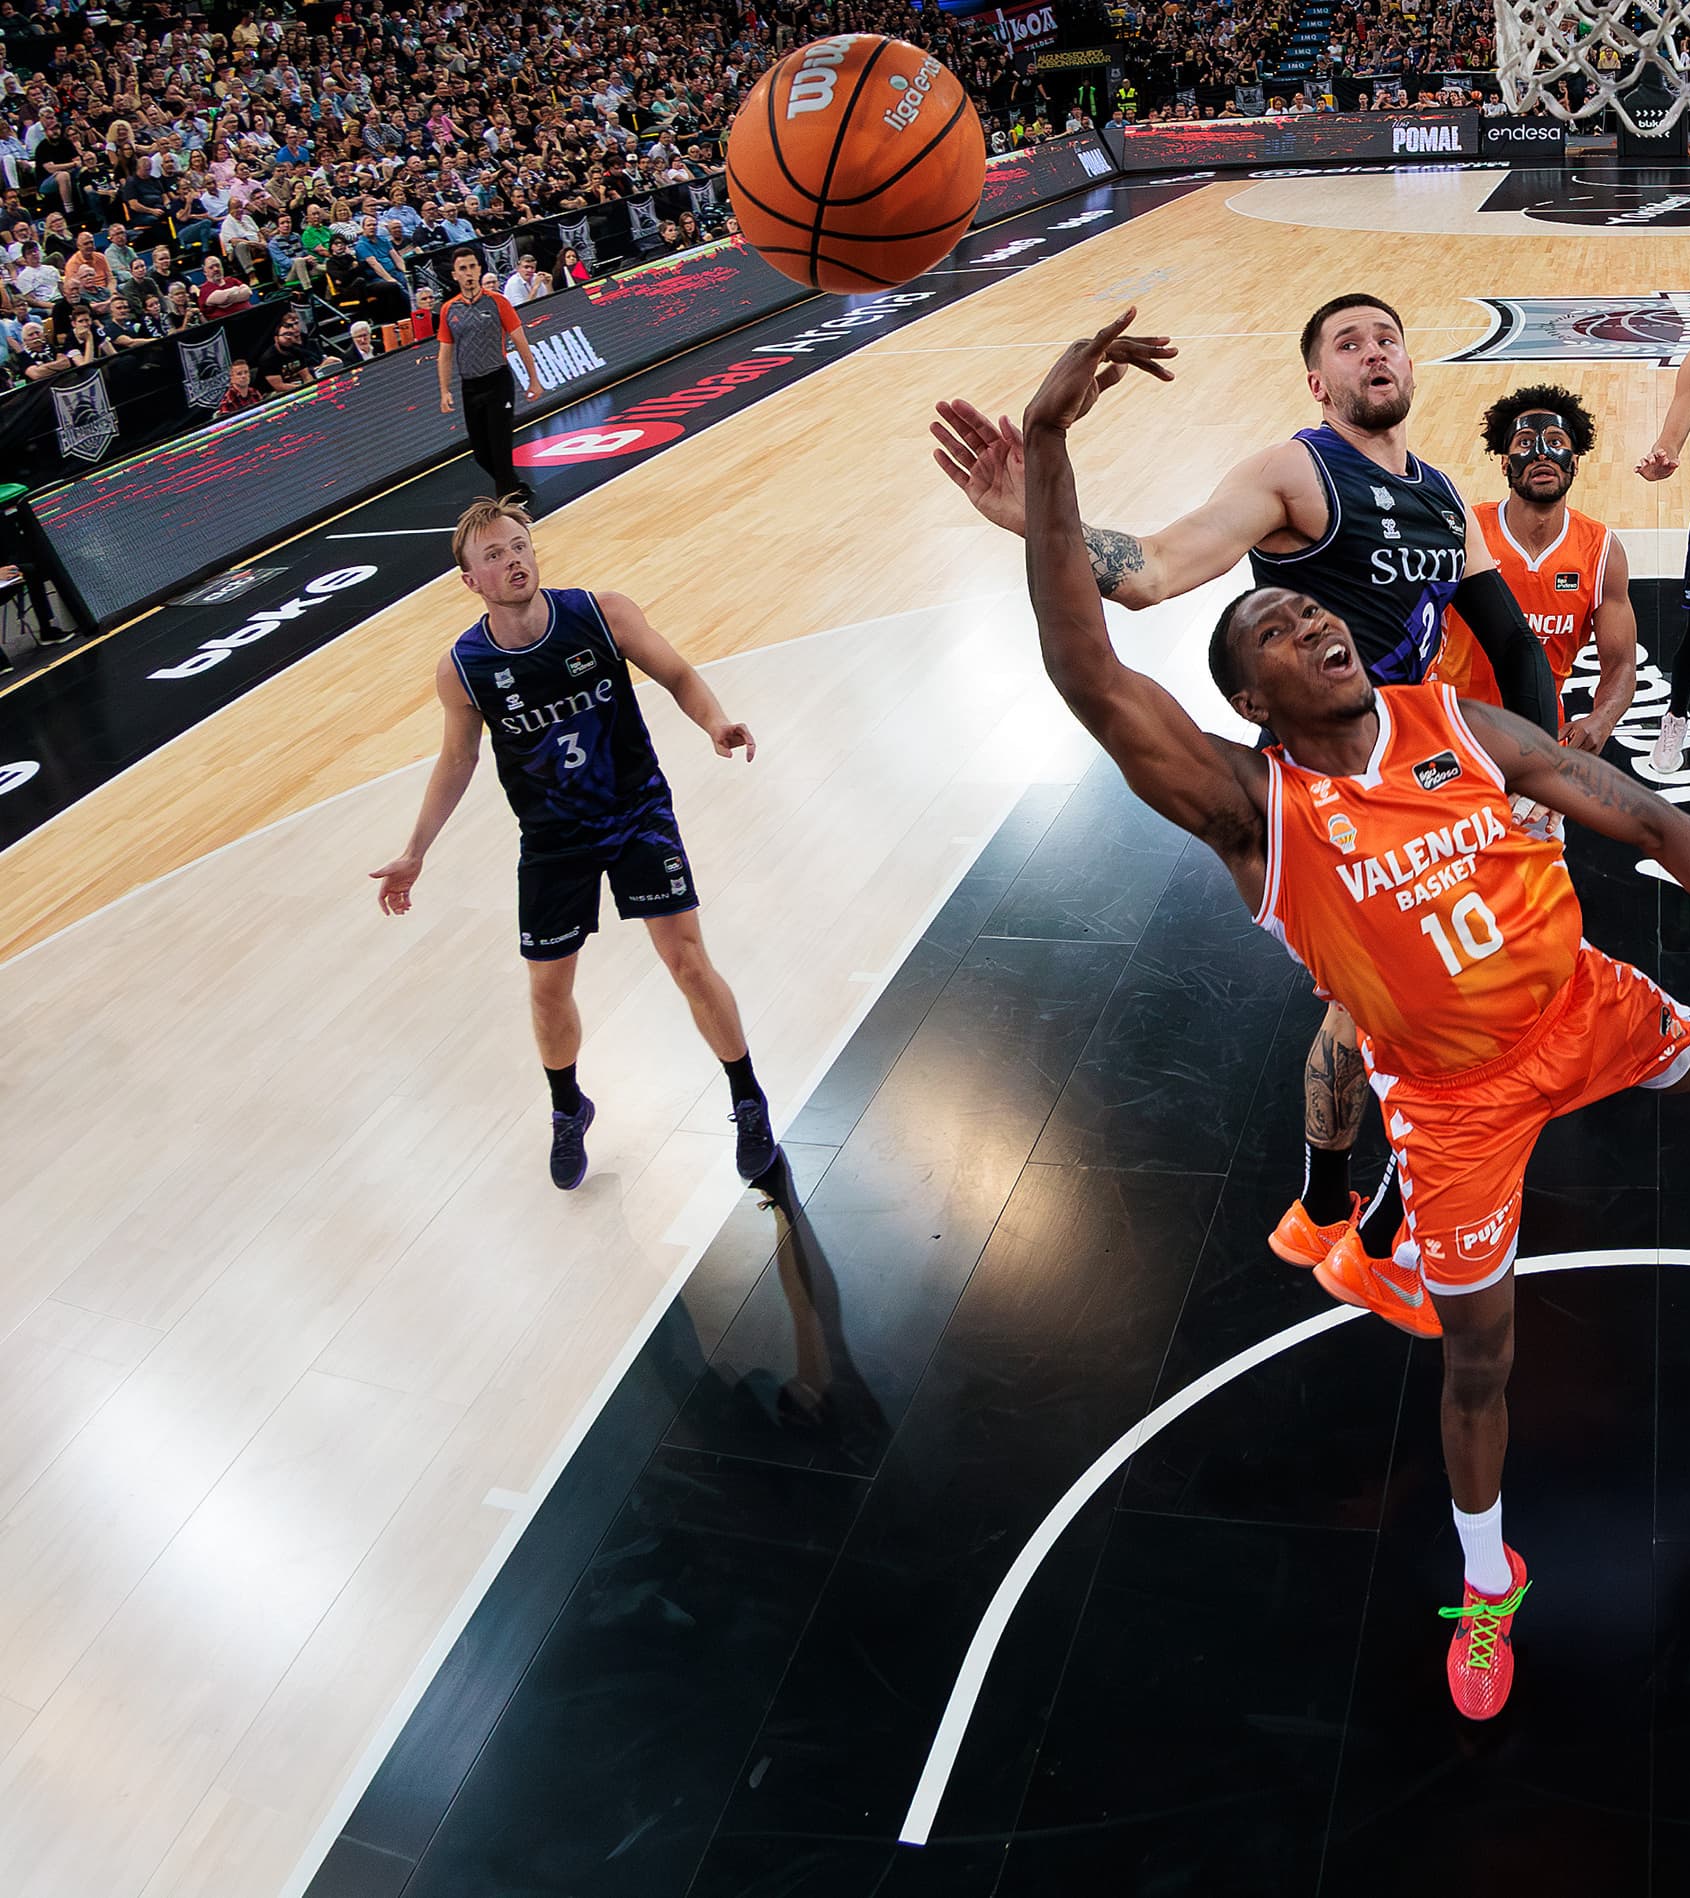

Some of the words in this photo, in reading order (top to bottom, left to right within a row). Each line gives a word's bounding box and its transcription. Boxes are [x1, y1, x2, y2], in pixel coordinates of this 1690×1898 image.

[1392, 126, 1462, 153] POMAL
[1487, 123, 1561, 142] endesa
[752, 290, 937, 353] Arena
[1371, 547, 1467, 585] surn
[1419, 601, 1435, 661] 2
[501, 678, 613, 735] surne
[556, 732, 588, 769] 3
[1335, 805, 1507, 904] VALENCIA
[1395, 853, 1477, 912] BASKET
[1420, 891, 1504, 977] 10
